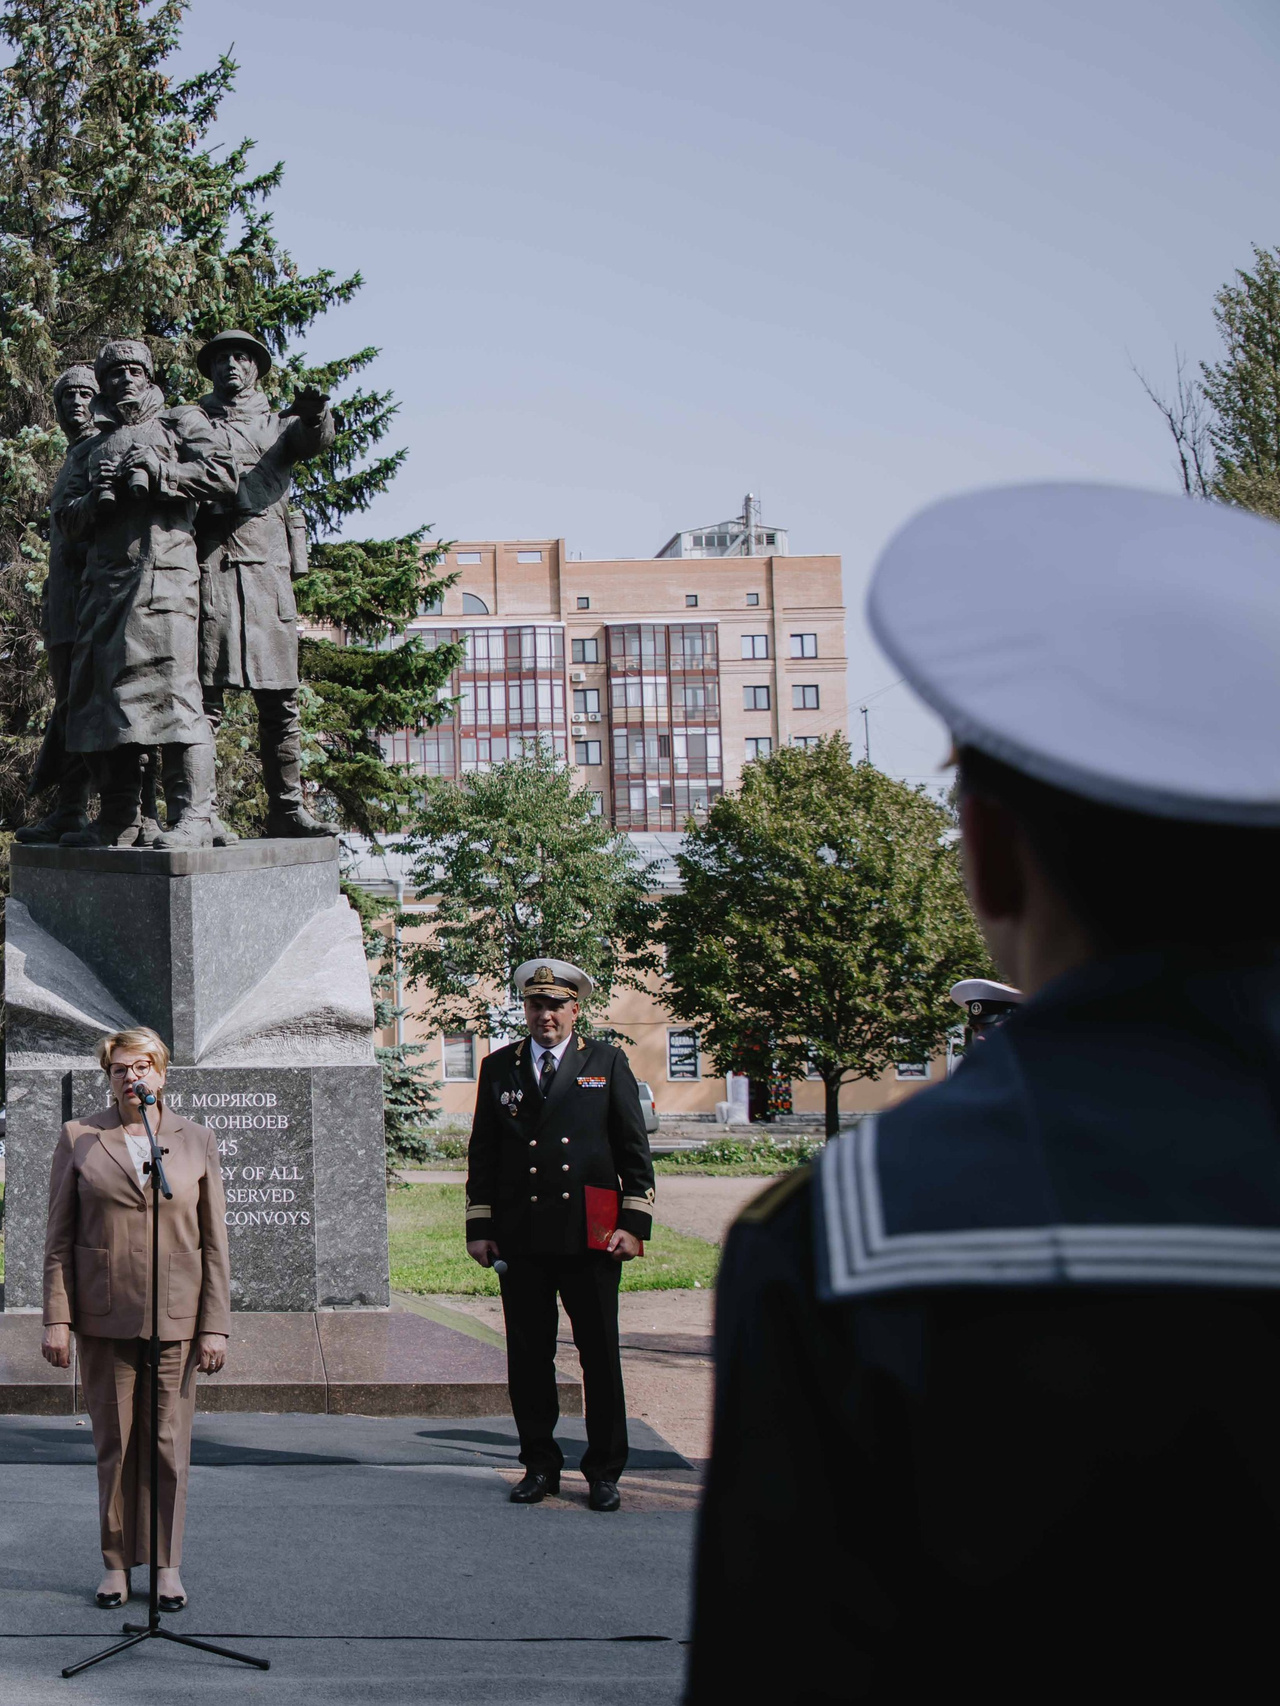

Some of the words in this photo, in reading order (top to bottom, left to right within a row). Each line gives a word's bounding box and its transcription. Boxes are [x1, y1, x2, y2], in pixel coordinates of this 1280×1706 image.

[192, 1093, 277, 1107] МОРЯКОВ
[205, 1115, 289, 1129] КОНВОЕВ
[242, 1166, 266, 1180] OF
[269, 1166, 304, 1180] ALL
[227, 1188, 295, 1203] SERVED
[224, 1211, 310, 1226] CONVOYS
